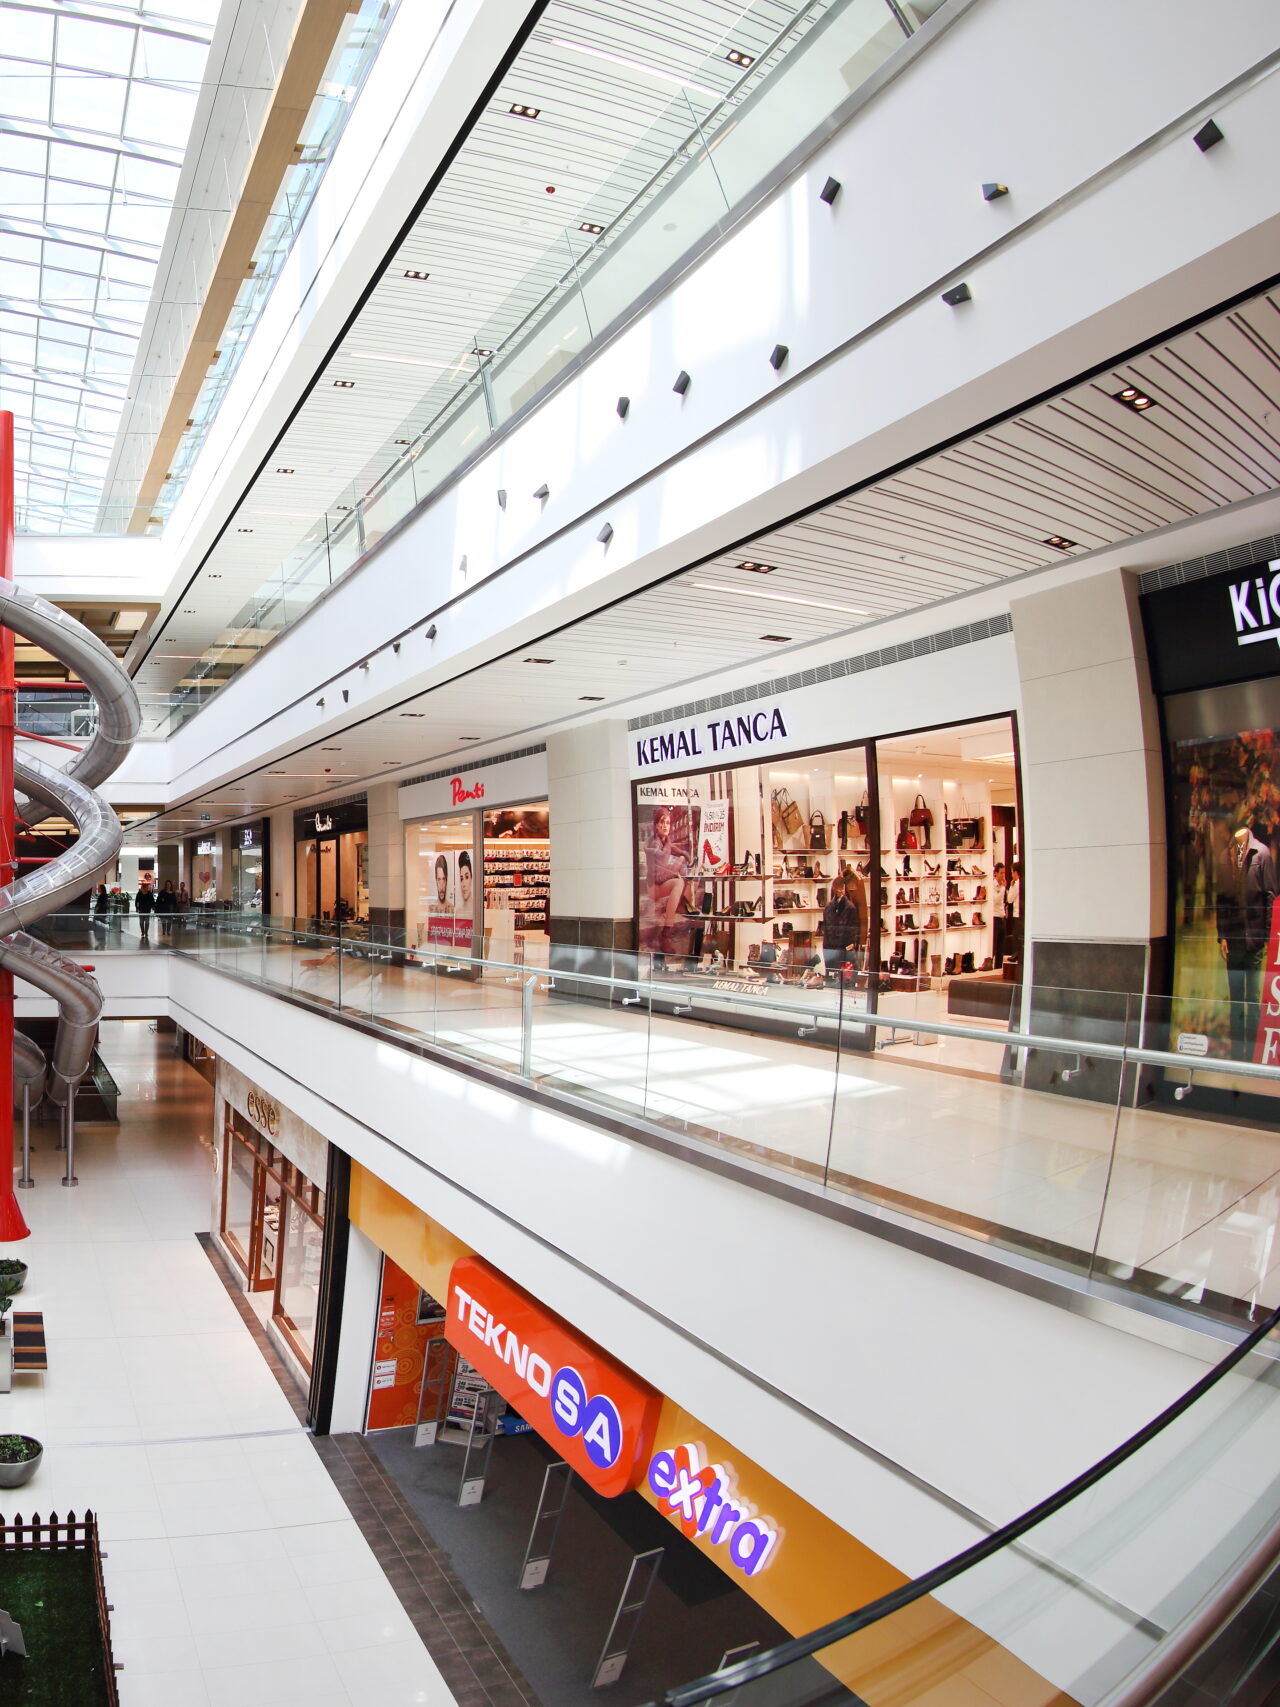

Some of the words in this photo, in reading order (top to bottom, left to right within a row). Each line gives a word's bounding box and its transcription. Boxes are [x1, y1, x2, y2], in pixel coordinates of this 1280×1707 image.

[636, 728, 702, 766] KEMAL
[707, 708, 788, 751] TANCA
[450, 777, 485, 806] Penti
[639, 786, 669, 798] KEMAL
[671, 787, 700, 798] TANCA
[713, 980, 740, 992] KEMAL
[740, 983, 769, 996] TANCA
[247, 1091, 277, 1136] esse
[454, 1284, 612, 1463] TEKNOSA
[514, 1422, 534, 1433] SAM
[648, 1445, 777, 1577] extra
